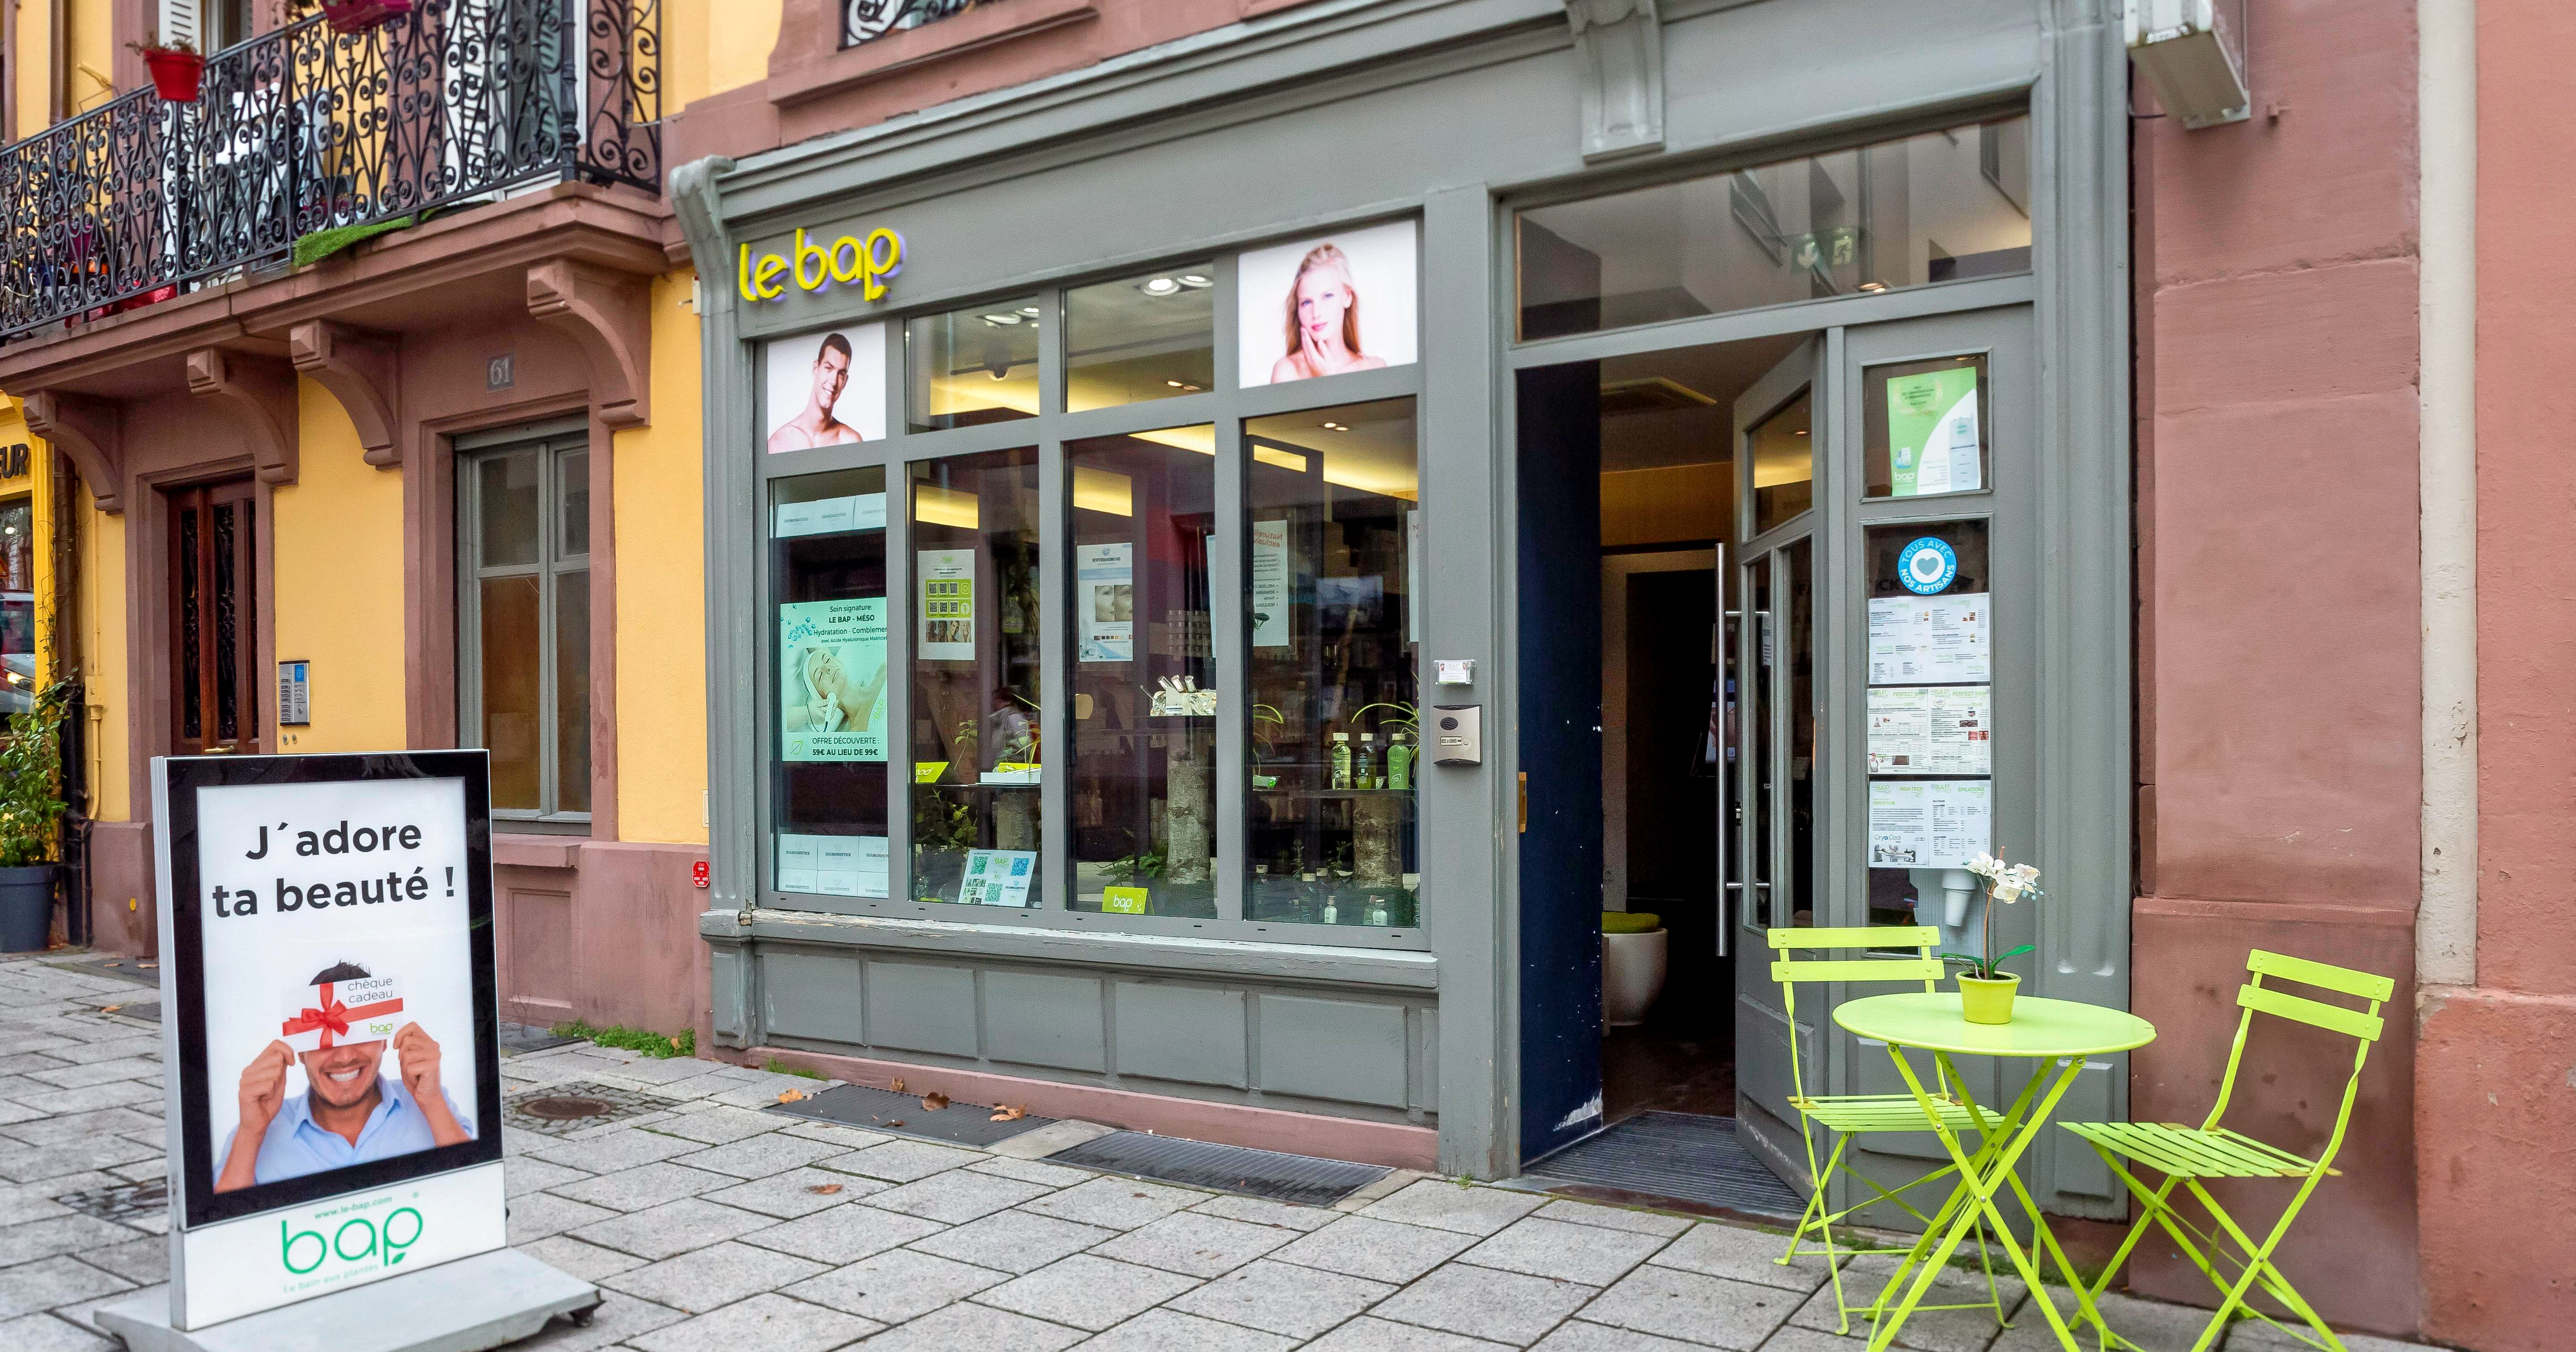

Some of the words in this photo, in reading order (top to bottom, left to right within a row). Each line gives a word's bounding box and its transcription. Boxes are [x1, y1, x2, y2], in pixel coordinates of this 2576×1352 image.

[739, 243, 788, 302] le
[795, 227, 900, 302] bap
[490, 358, 509, 385] 61
[0, 443, 29, 479] UR
[1902, 541, 1924, 562] TOUS
[1927, 540, 1952, 558] AVEC
[1901, 569, 1915, 587] NOS
[1915, 565, 1954, 592] ARTISANS
[843, 604, 873, 613] signature:
[856, 613, 875, 621] MÉSO
[813, 628, 847, 637] Hydratation
[834, 735, 876, 744] DÉCOUVERTE
[212, 886, 258, 918] ta
[276, 866, 428, 912] beauté
[445, 866, 454, 897] !
[1114, 894, 1132, 912] bap
[348, 978, 392, 991] chèque
[349, 990, 392, 1003] cadeau
[370, 1023, 393, 1034] bap
[314, 1196, 393, 1219] www.le-bap.com
[282, 1207, 423, 1274] bap
